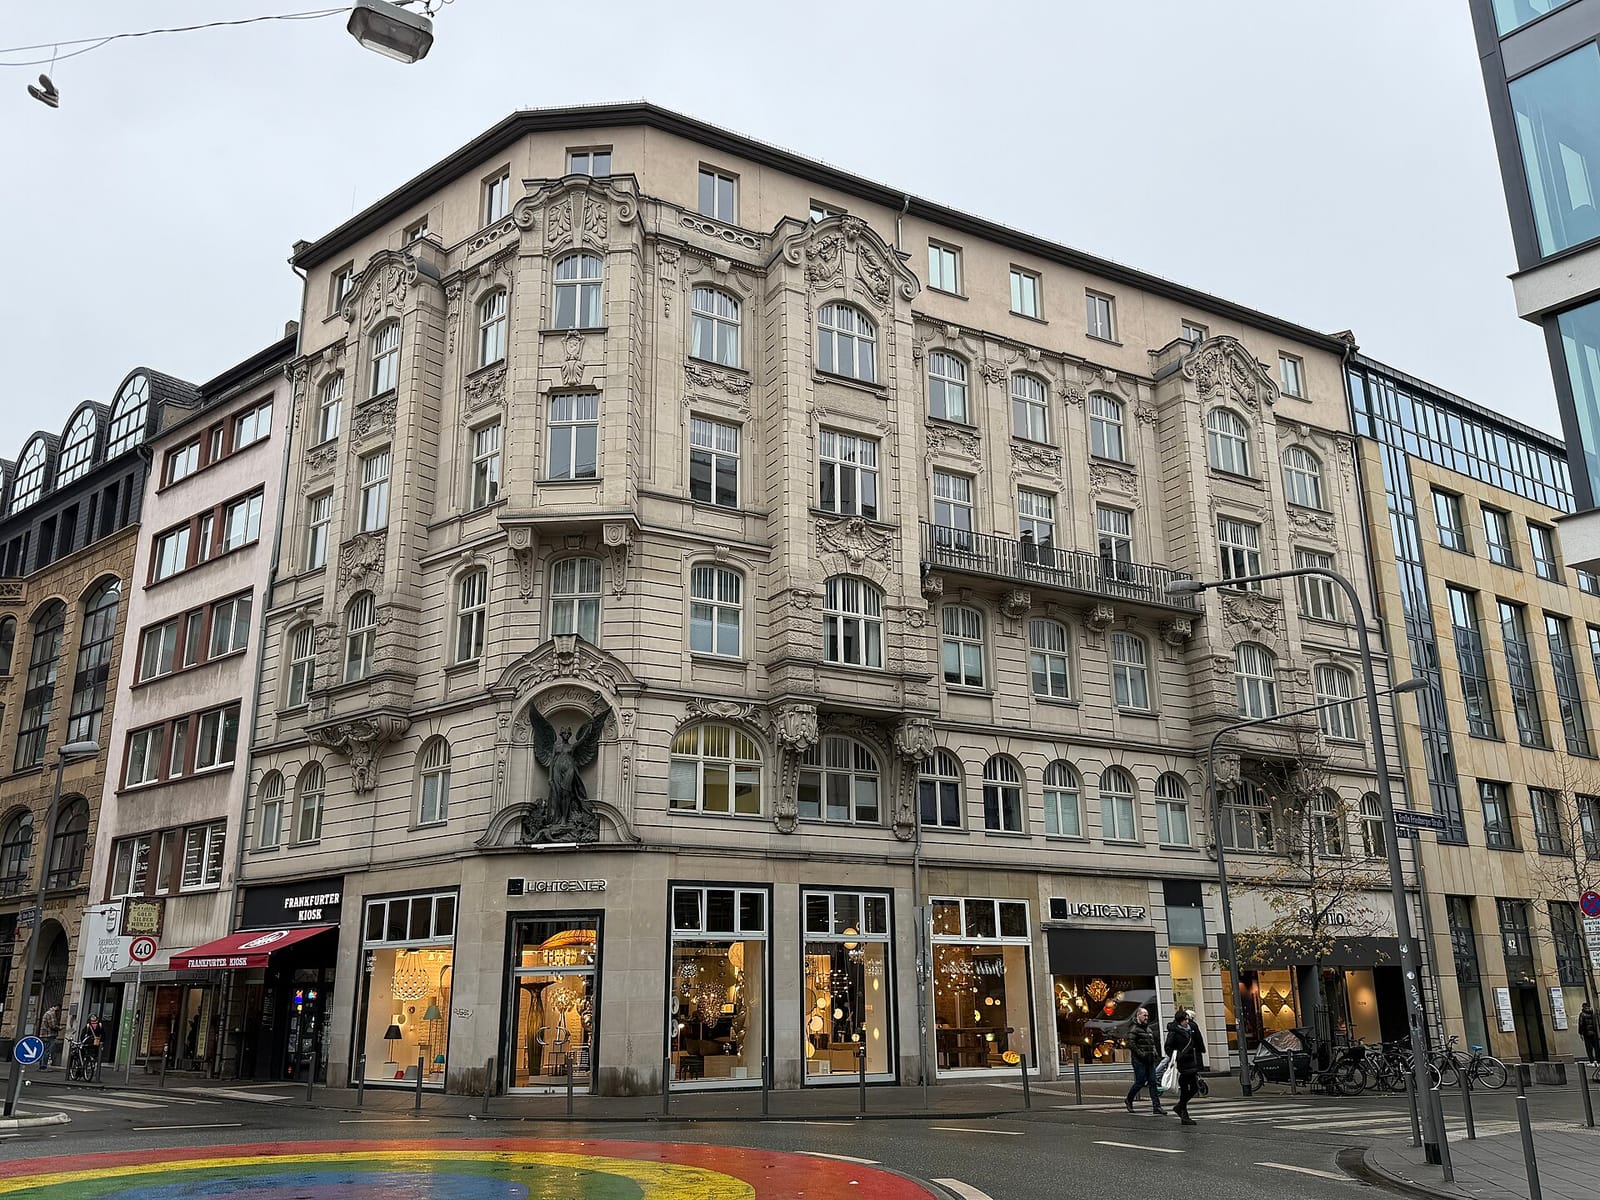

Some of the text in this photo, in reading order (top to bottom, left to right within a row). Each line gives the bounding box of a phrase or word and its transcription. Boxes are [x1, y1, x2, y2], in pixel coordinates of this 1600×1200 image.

[284, 893, 340, 909] FRANKFURTER
[298, 909, 322, 921] KIOSK
[135, 943, 152, 955] 40
[1508, 940, 1516, 949] 42
[1160, 951, 1167, 959] 44
[187, 957, 248, 968] FRANKFURTER KIOSK
